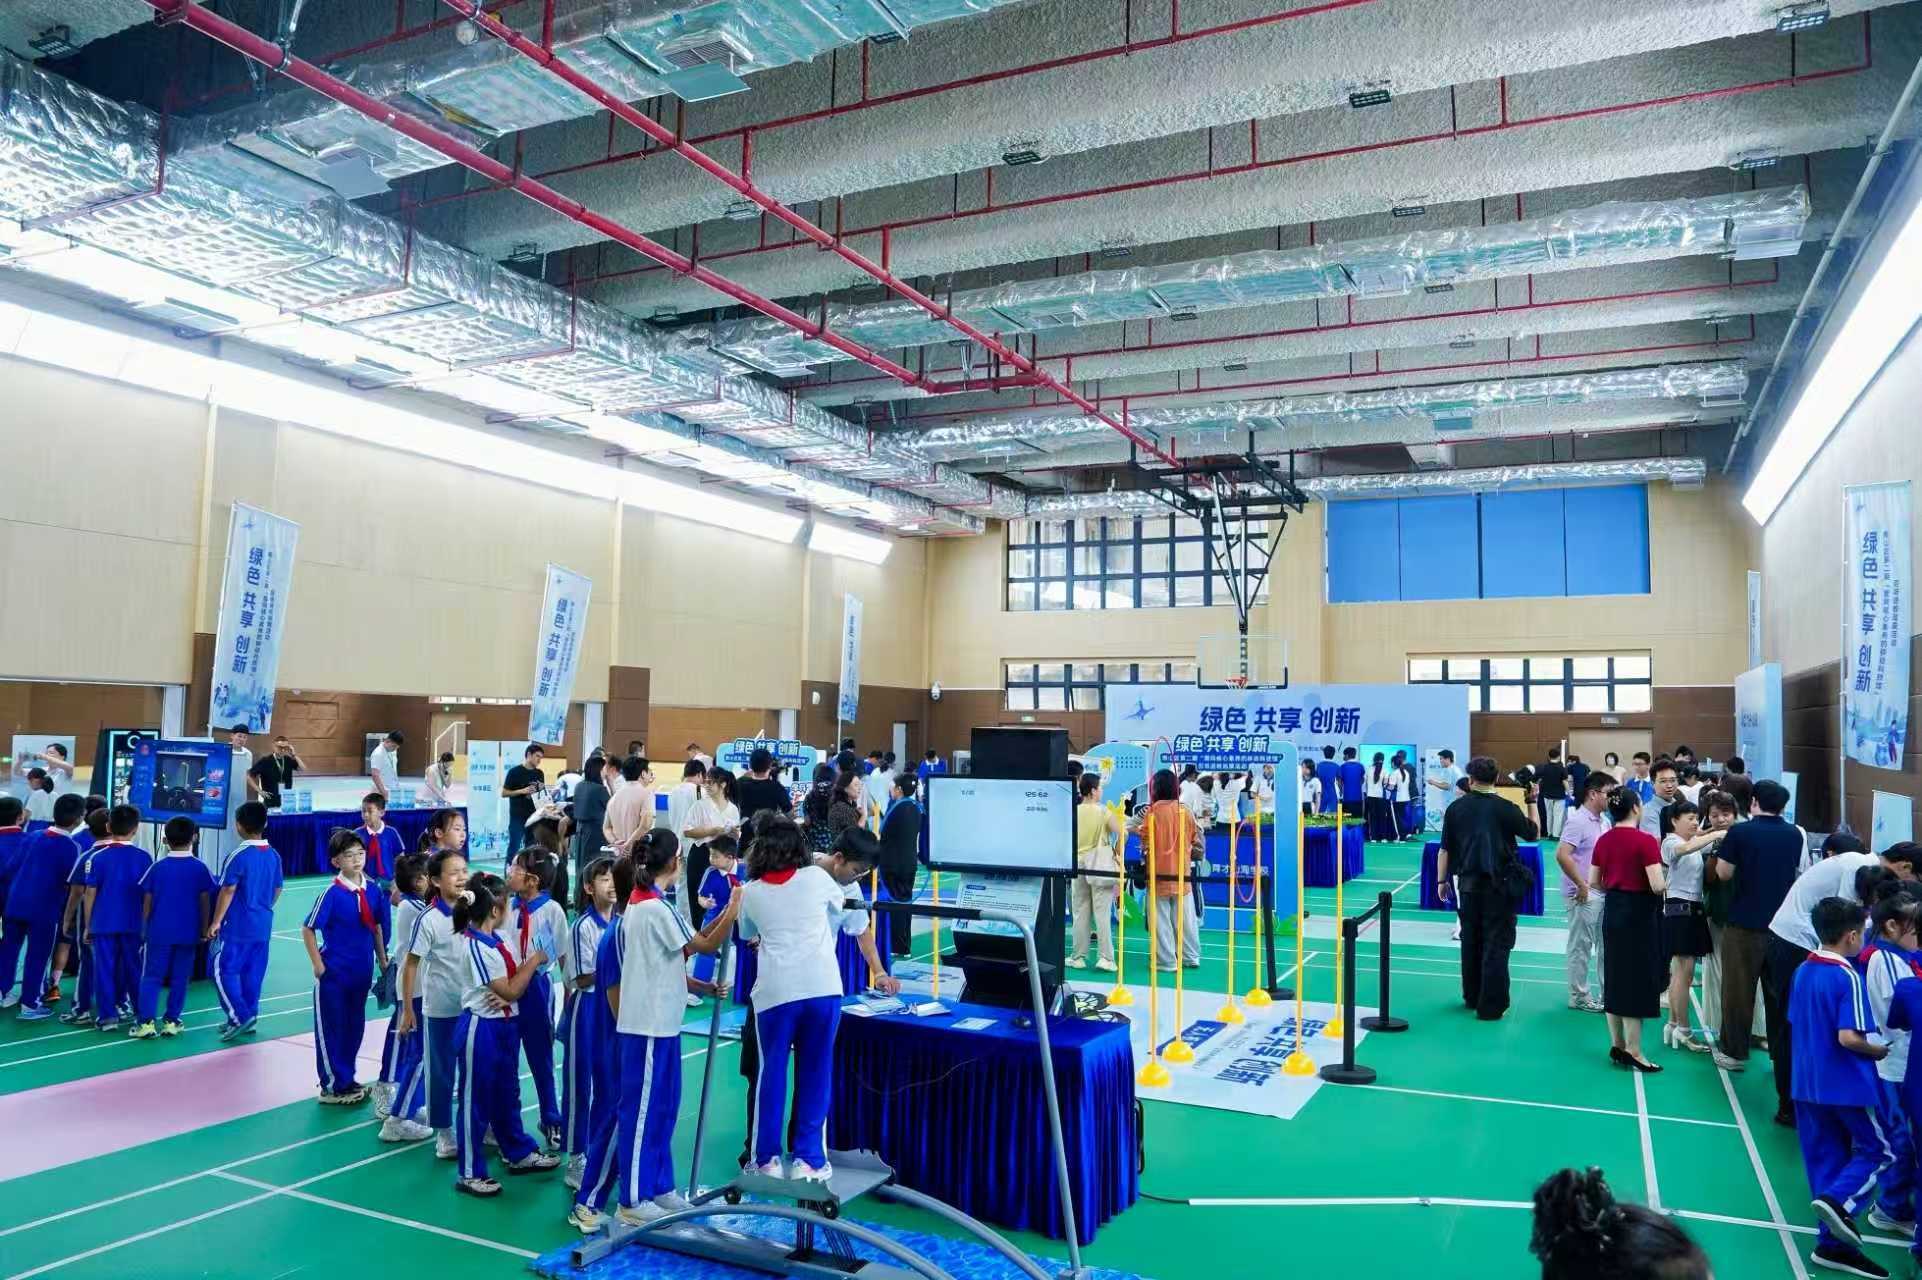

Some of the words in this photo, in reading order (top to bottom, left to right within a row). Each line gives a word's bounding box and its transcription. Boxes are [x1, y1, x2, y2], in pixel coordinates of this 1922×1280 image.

[247, 546, 264, 586] 绿色
[1862, 531, 1878, 580] 绿色
[239, 591, 257, 628] 共享
[553, 597, 568, 629] 绿色
[1861, 588, 1877, 636] 共享
[231, 634, 250, 674] 创新
[1855, 644, 1872, 693] 创新
[1199, 706, 1247, 733] 绿色
[1253, 706, 1303, 734] 共享
[1309, 706, 1361, 735] 创新
[1175, 736, 1203, 752] 绿色
[1206, 736, 1235, 752] 共享
[1238, 736, 1269, 752] 创新
